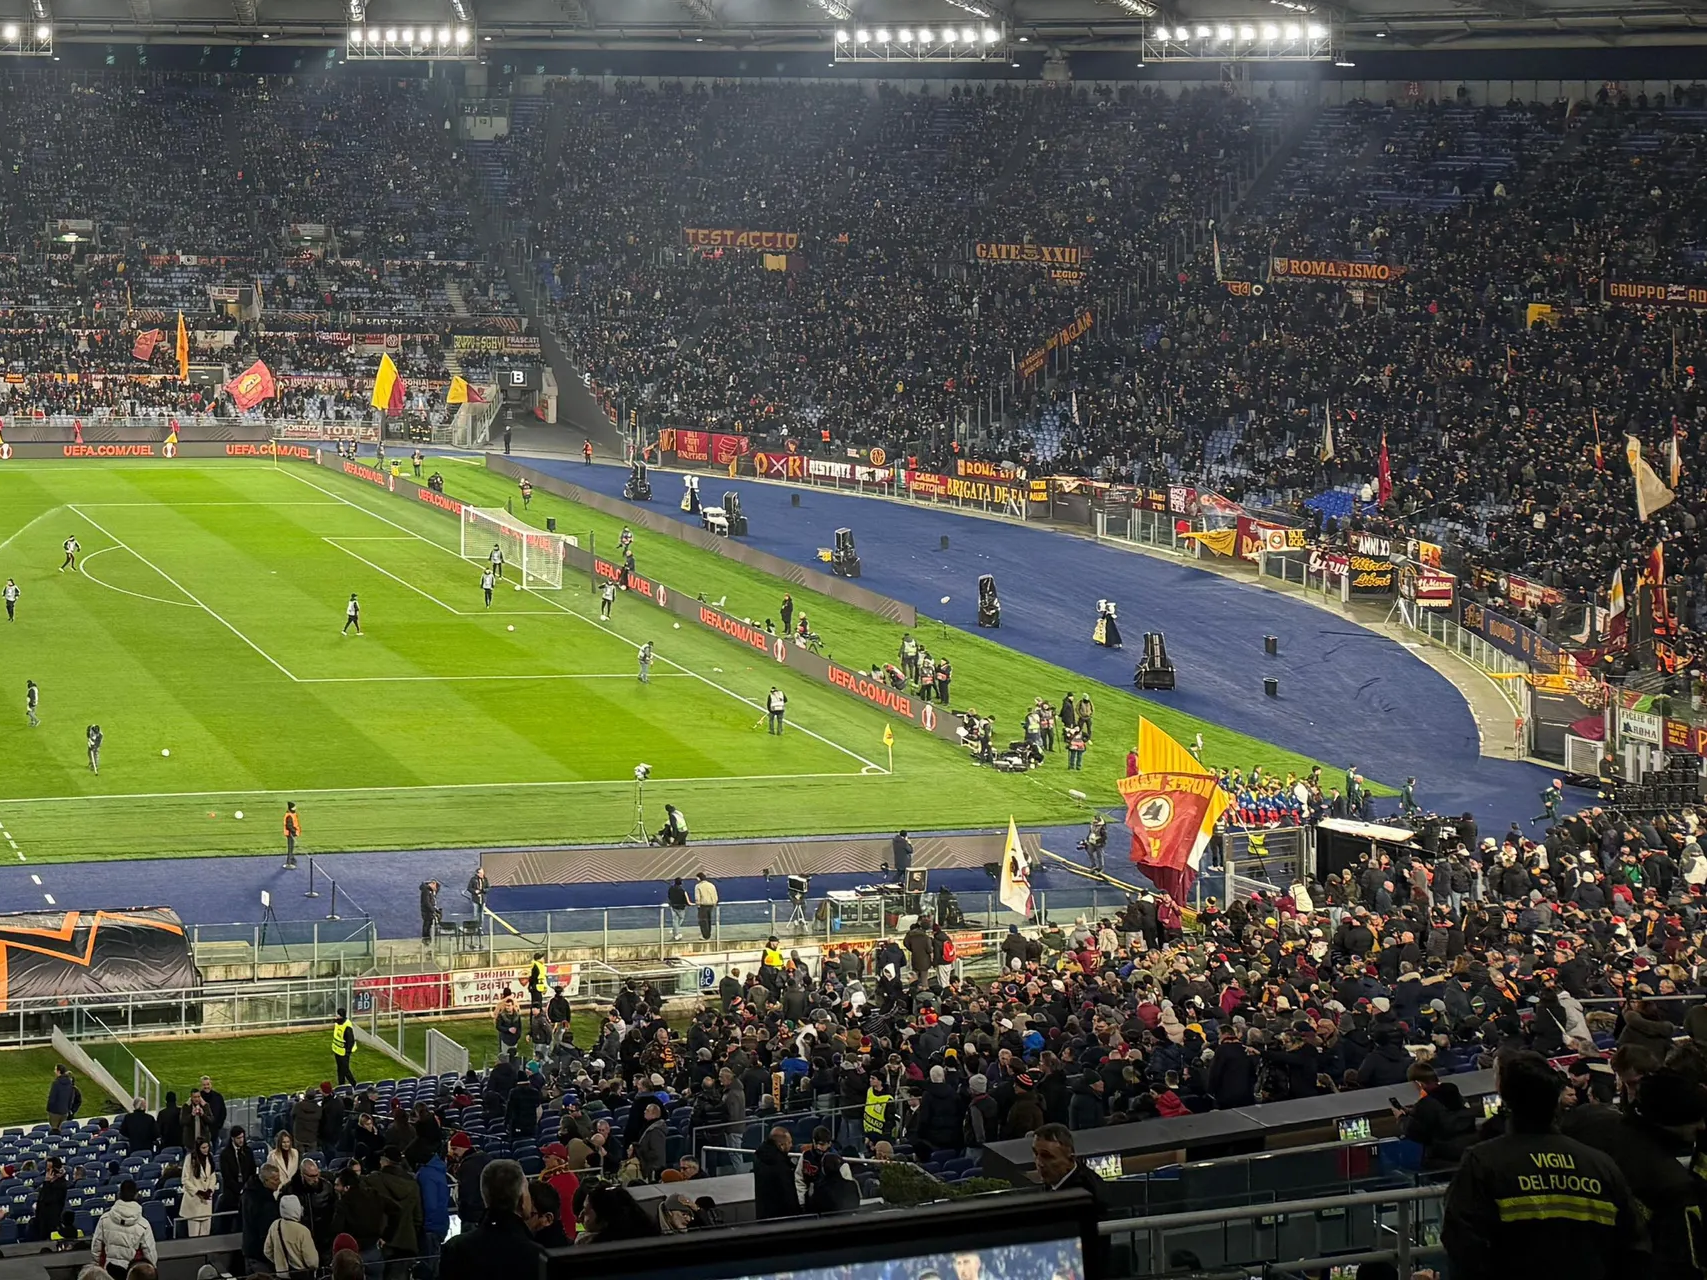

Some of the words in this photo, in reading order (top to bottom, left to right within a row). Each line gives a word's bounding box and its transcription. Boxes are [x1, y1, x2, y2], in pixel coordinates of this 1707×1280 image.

[685, 228, 798, 249] TESTACCIO
[976, 243, 1020, 260] GATE
[1051, 269, 1078, 279] LEGIO
[1289, 259, 1389, 280] ROMANISMO
[1610, 283, 1665, 299] GRUPPO
[507, 336, 540, 344] FRASCATI
[513, 368, 524, 383] B
[63, 444, 155, 457] UEFA.COM/UEL
[225, 443, 311, 459] UEFA.COM/UEL
[342, 460, 386, 486] UEFA.COM/UEL
[966, 461, 997, 478] ROMA
[947, 477, 991, 502] BRIGATA
[418, 488, 464, 515] UEFA.COM/UE
[595, 559, 653, 598] UEFA.CM/UEL
[700, 607, 769, 652] UEFA.COM/UEL
[828, 665, 915, 719] UEFA.COM/UEL
[1633, 725, 1657, 740] ROMA
[1529, 1152, 1576, 1170] VIGILI
[1518, 1174, 1550, 1192] DEL
[1550, 1174, 1602, 1195] FUOCO
